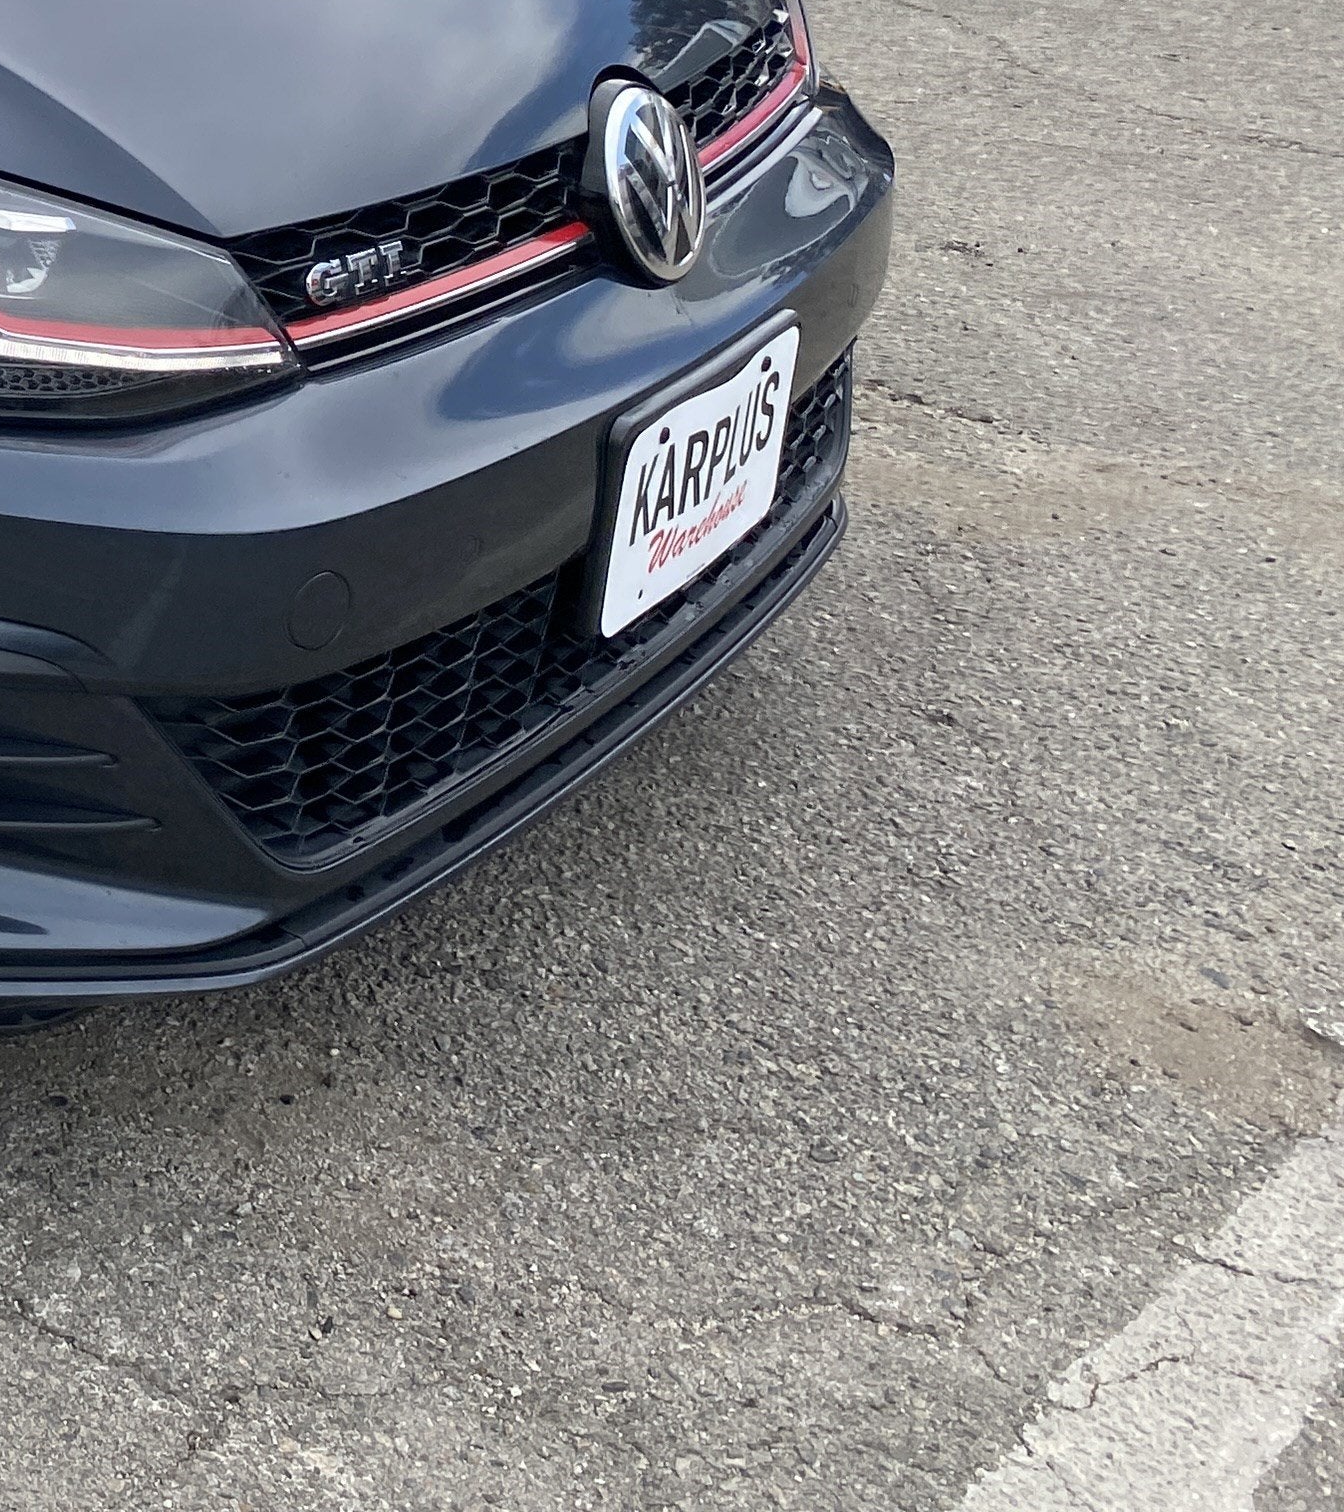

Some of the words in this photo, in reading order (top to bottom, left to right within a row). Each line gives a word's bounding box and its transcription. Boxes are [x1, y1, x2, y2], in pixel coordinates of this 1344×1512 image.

[306, 240, 407, 307] GTI
[628, 371, 780, 547] KARPLUS
[647, 479, 749, 574] Warehouse
